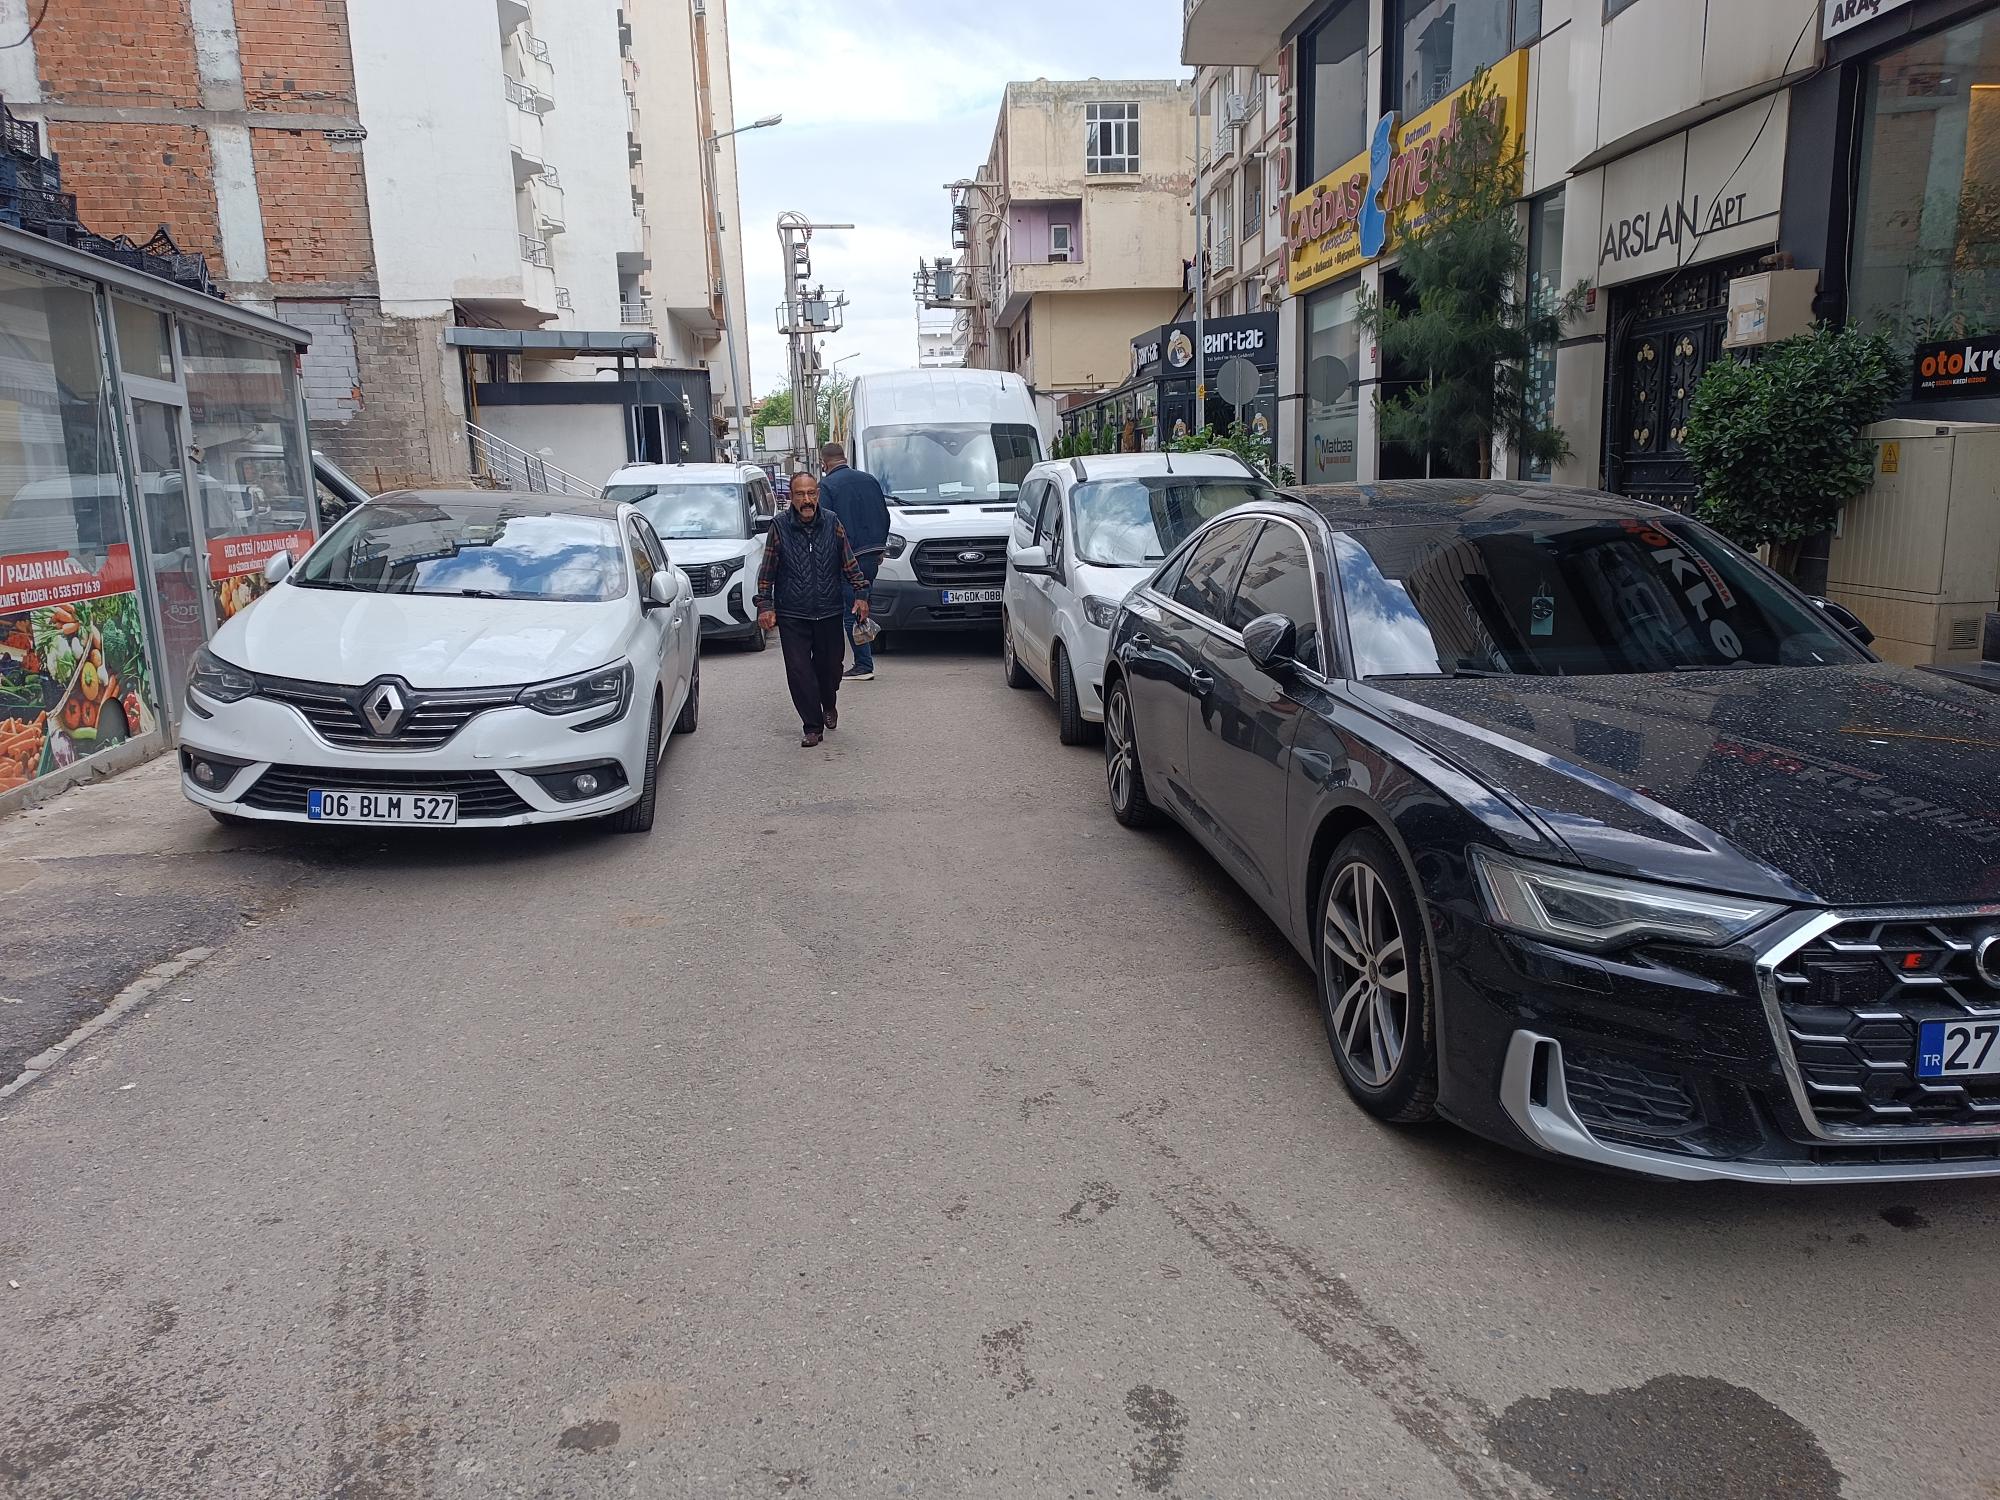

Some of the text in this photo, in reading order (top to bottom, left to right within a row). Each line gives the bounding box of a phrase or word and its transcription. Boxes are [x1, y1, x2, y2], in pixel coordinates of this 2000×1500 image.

[1600, 193, 1747, 266] ARSLAN APT
[6, 562, 43, 583] PAZAR
[20, 588, 49, 605] BİZDEN
[59, 585, 72, 599] 535
[72, 583, 84, 597] 577
[84, 582, 92, 594] 16
[92, 580, 101, 593] 39
[949, 592, 960, 602] 34
[311, 794, 455, 820] TR 06 BLM 527
[1923, 1025, 2000, 1071] TR 27
